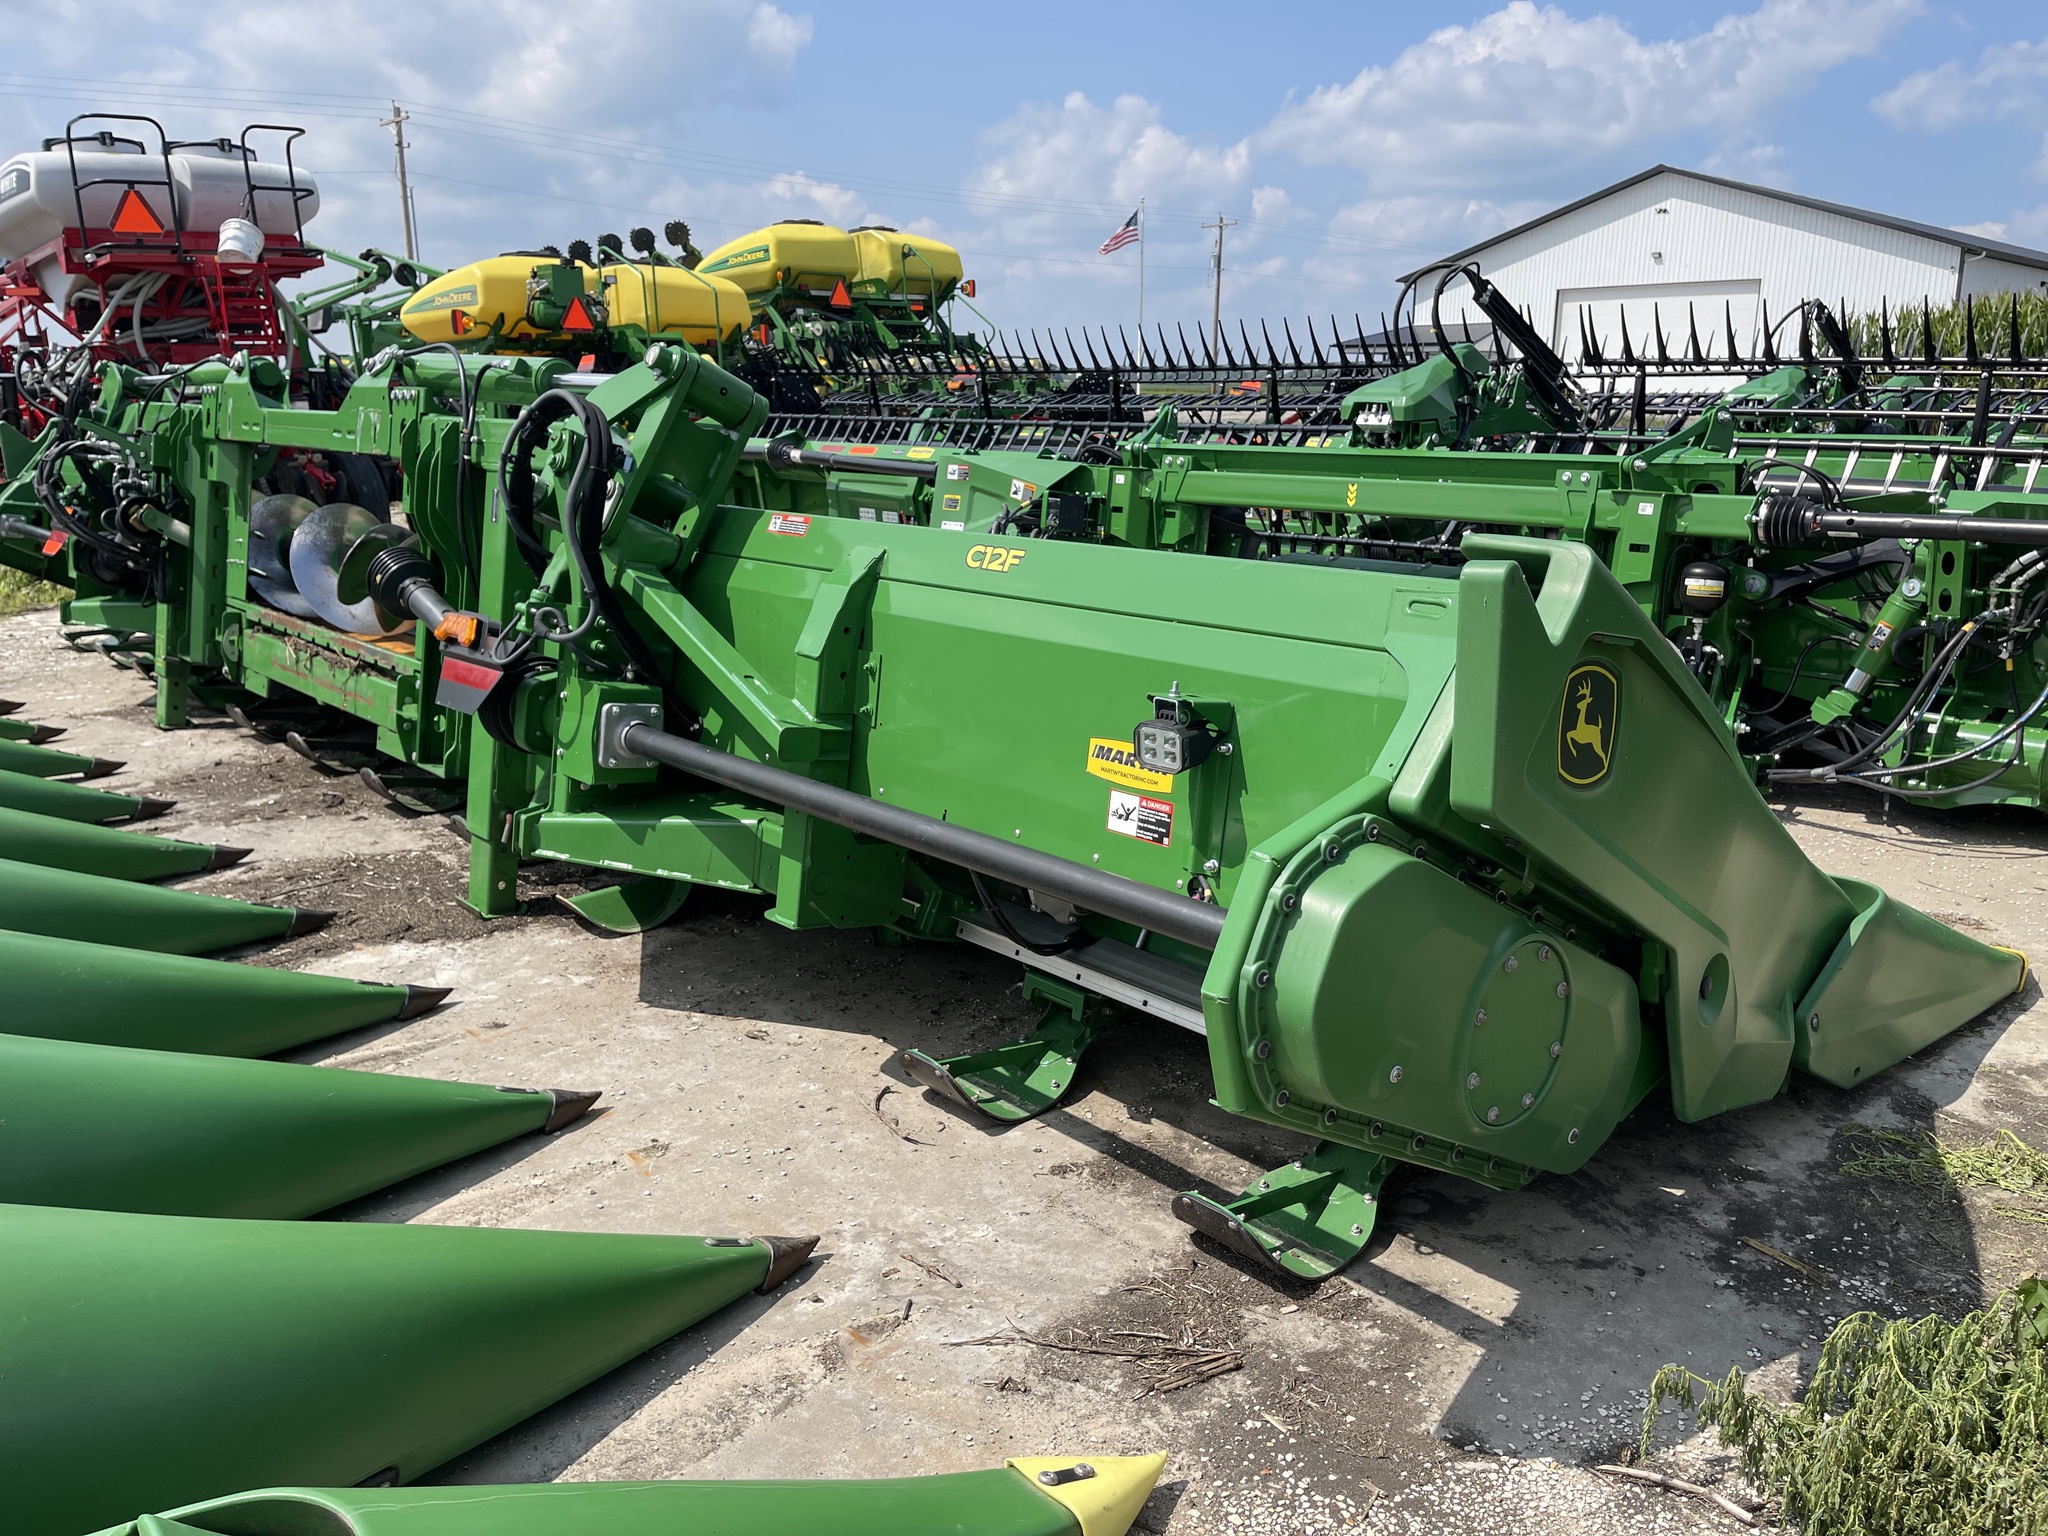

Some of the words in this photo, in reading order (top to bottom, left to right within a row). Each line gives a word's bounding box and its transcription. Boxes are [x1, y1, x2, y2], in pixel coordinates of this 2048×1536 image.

[727, 256, 743, 265] JOHN
[743, 251, 765, 262] DEERE
[433, 294, 450, 306] JOHN
[450, 292, 472, 303] DEERE
[965, 543, 1027, 573] C12F
[1100, 766, 1159, 786] MARTINTRACTORINC.COM
[1147, 801, 1170, 812] DANGER
